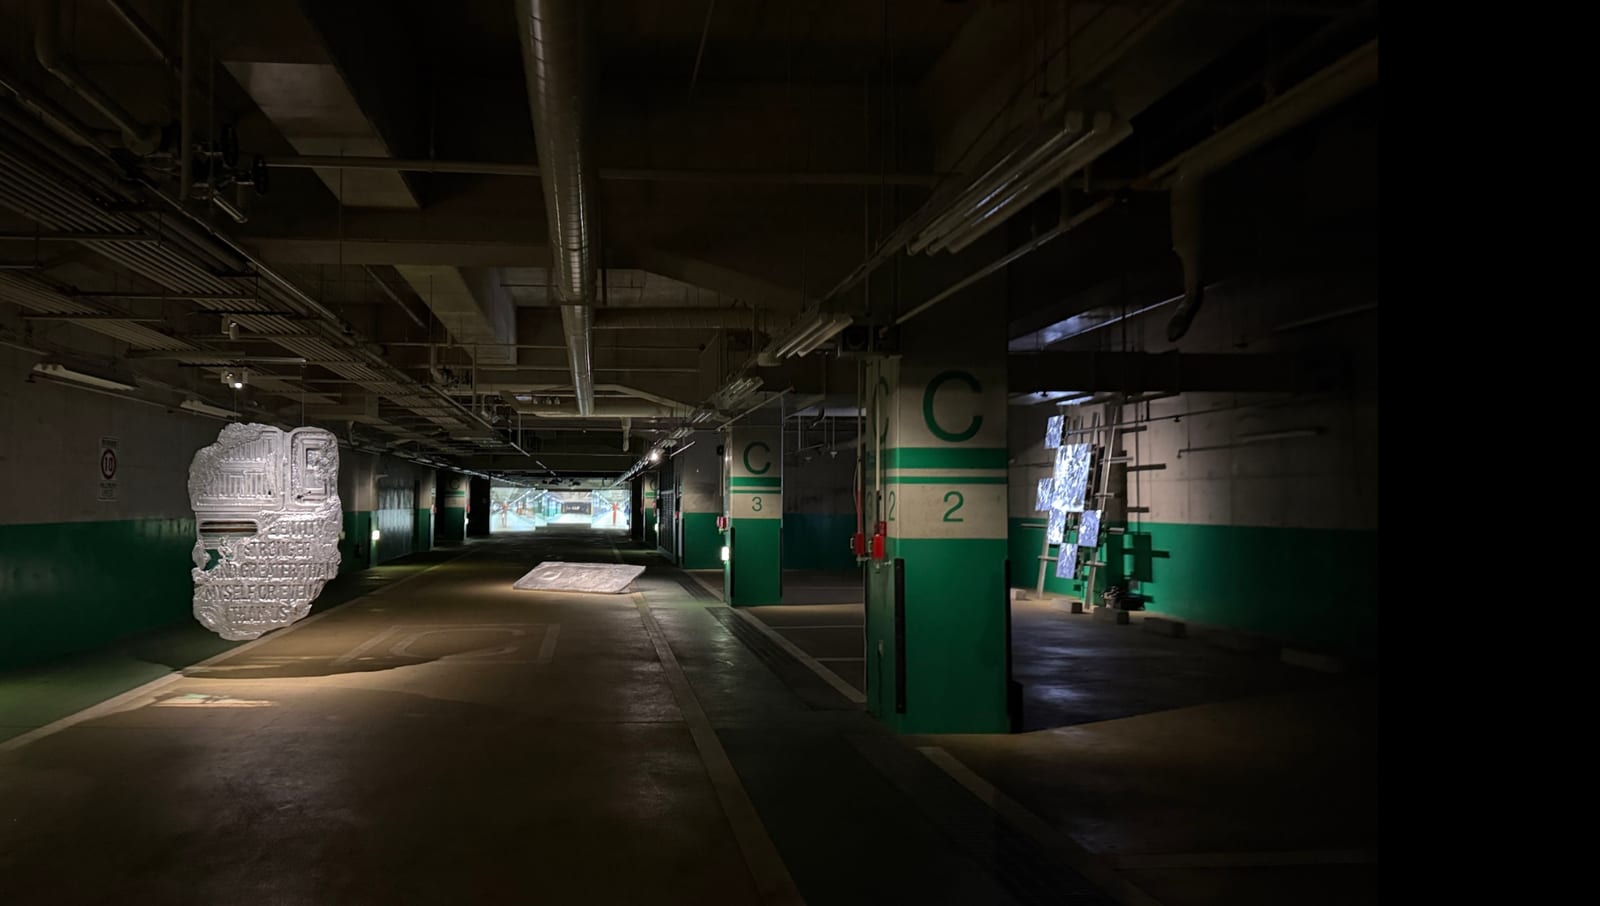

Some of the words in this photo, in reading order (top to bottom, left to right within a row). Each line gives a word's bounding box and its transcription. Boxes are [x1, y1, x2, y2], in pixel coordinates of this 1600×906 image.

[923, 370, 983, 442] C
[743, 441, 771, 475] C
[751, 496, 763, 512] 3
[888, 490, 897, 521] 2
[943, 491, 964, 522] 2
